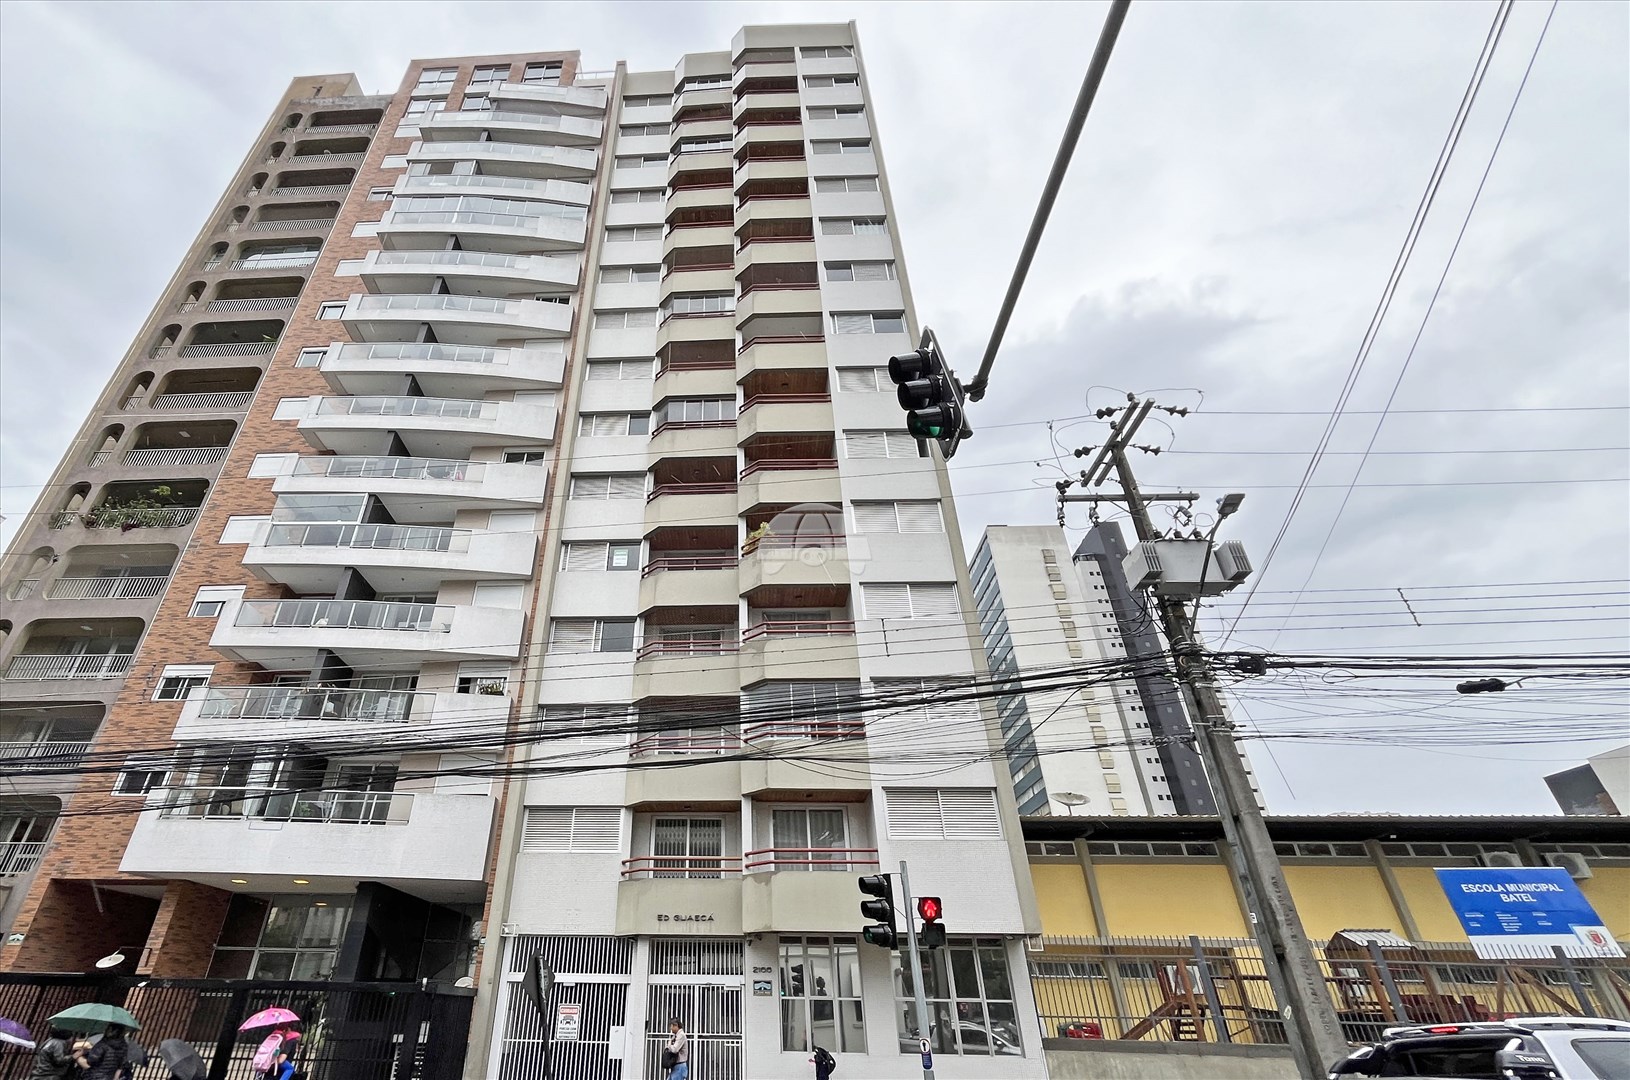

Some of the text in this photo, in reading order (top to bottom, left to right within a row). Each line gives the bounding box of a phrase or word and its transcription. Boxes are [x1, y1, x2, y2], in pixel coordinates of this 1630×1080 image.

[1461, 883, 1564, 893] ESCOLA MUNICIPAL
[1500, 893, 1538, 903] BATEL
[657, 914, 670, 922] ED
